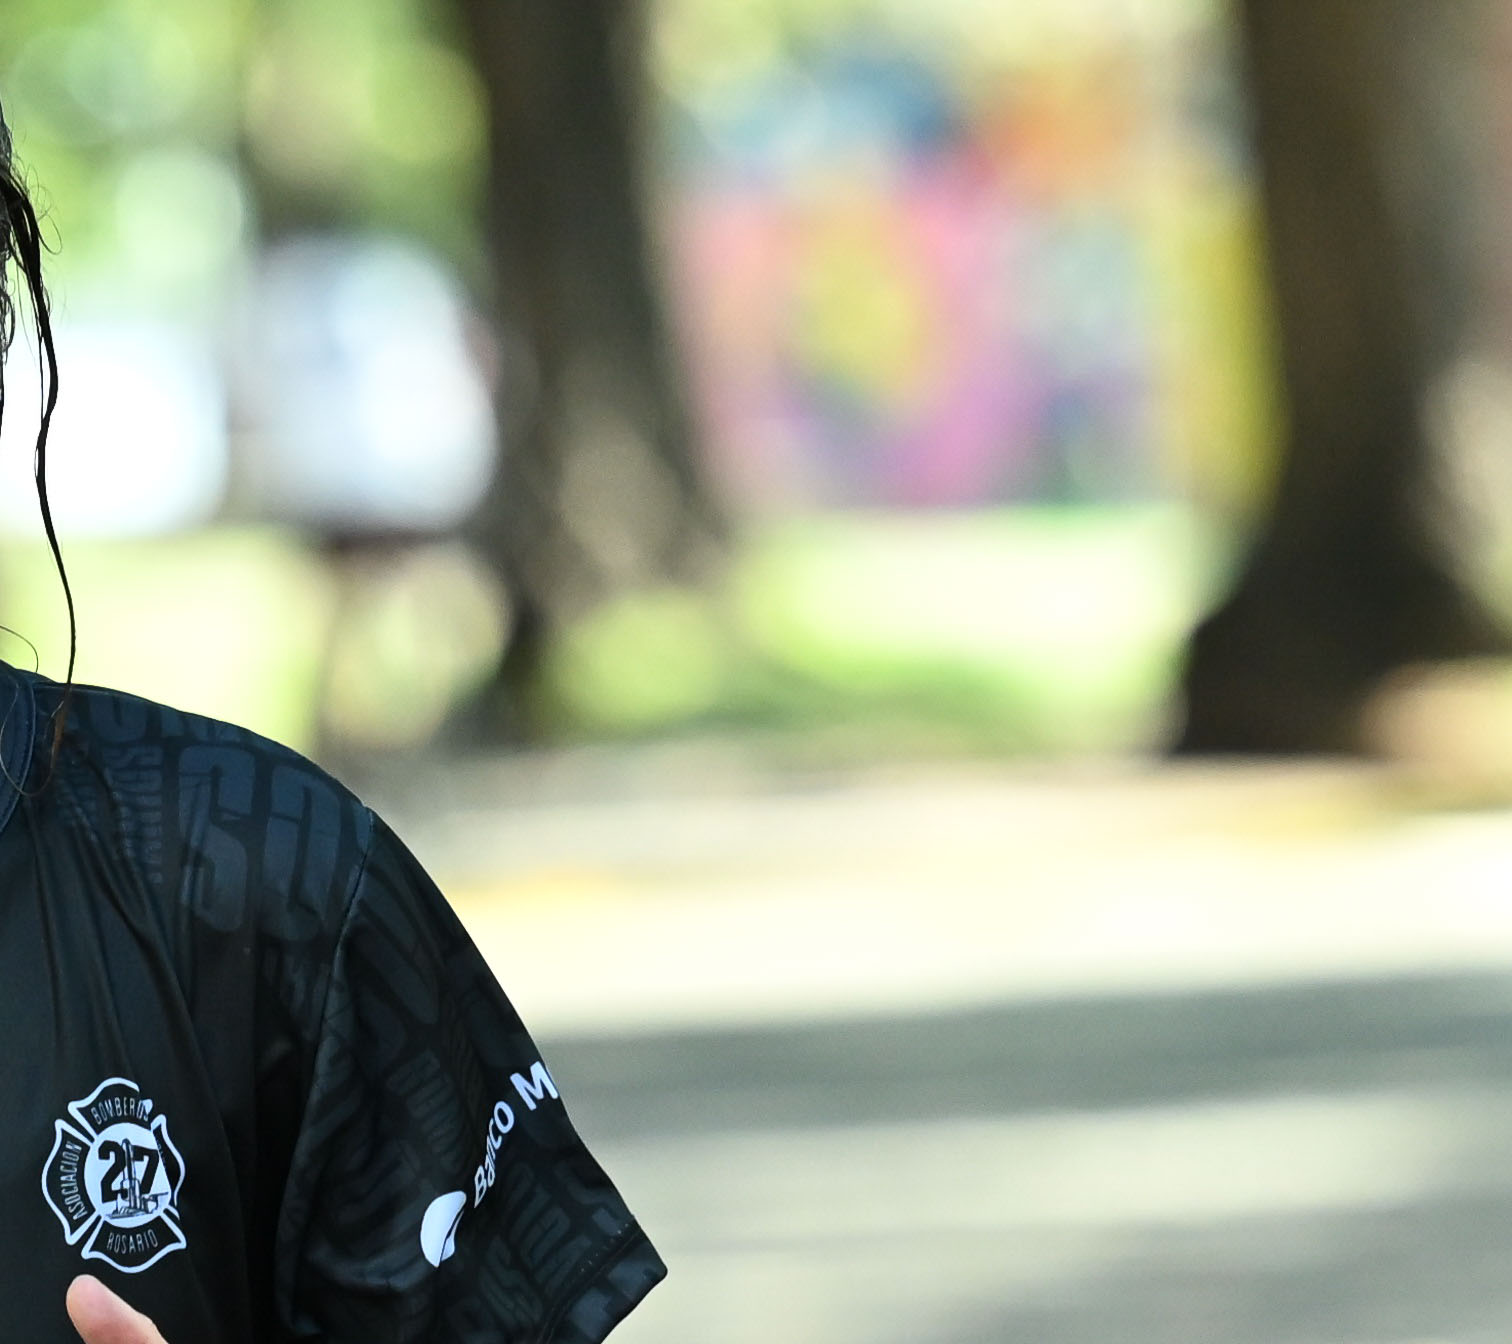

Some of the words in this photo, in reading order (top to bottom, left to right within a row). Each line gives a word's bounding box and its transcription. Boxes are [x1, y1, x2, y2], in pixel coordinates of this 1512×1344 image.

[509, 1060, 560, 1112] M
[97, 1139, 161, 1205] 27
[107, 1228, 160, 1256] ROSARIO
